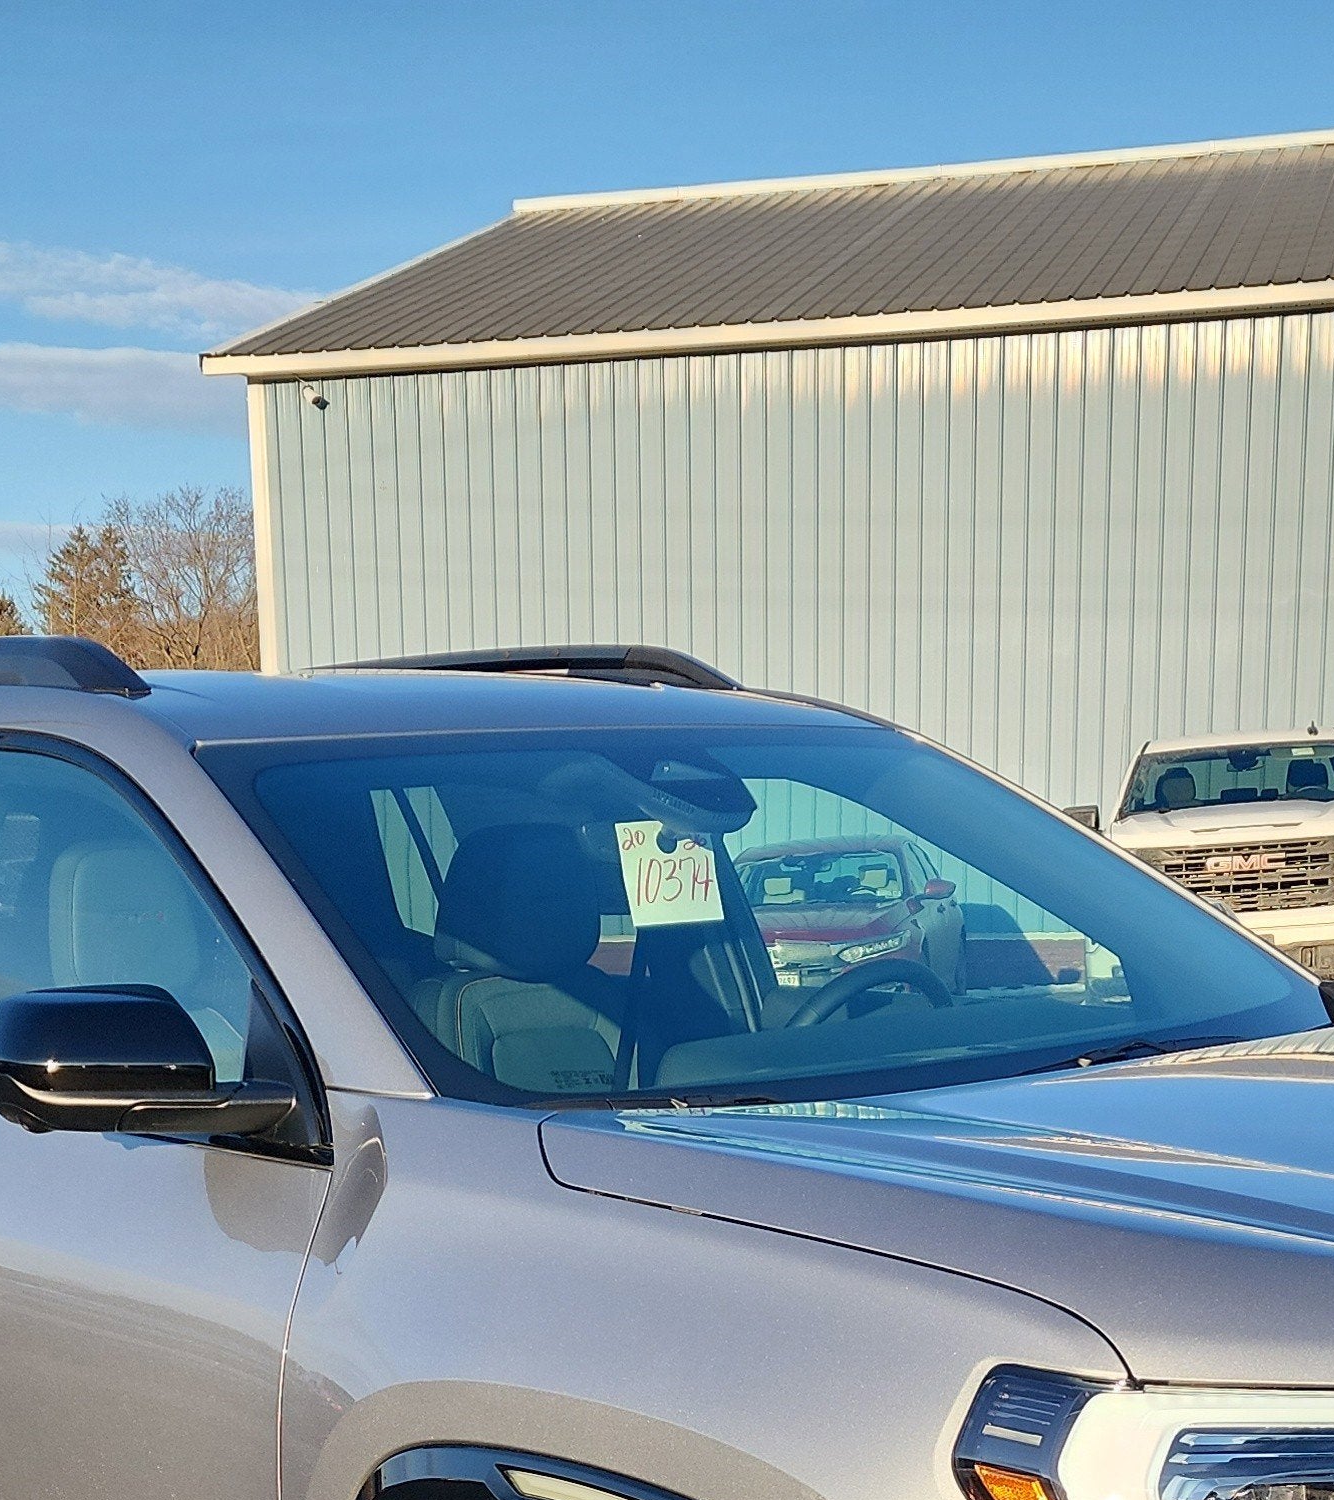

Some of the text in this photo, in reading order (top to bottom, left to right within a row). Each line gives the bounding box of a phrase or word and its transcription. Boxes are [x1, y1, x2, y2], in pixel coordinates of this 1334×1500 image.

[622, 827, 645, 850] 20
[1206, 852, 1286, 872] GMC
[637, 855, 714, 906] 10374
